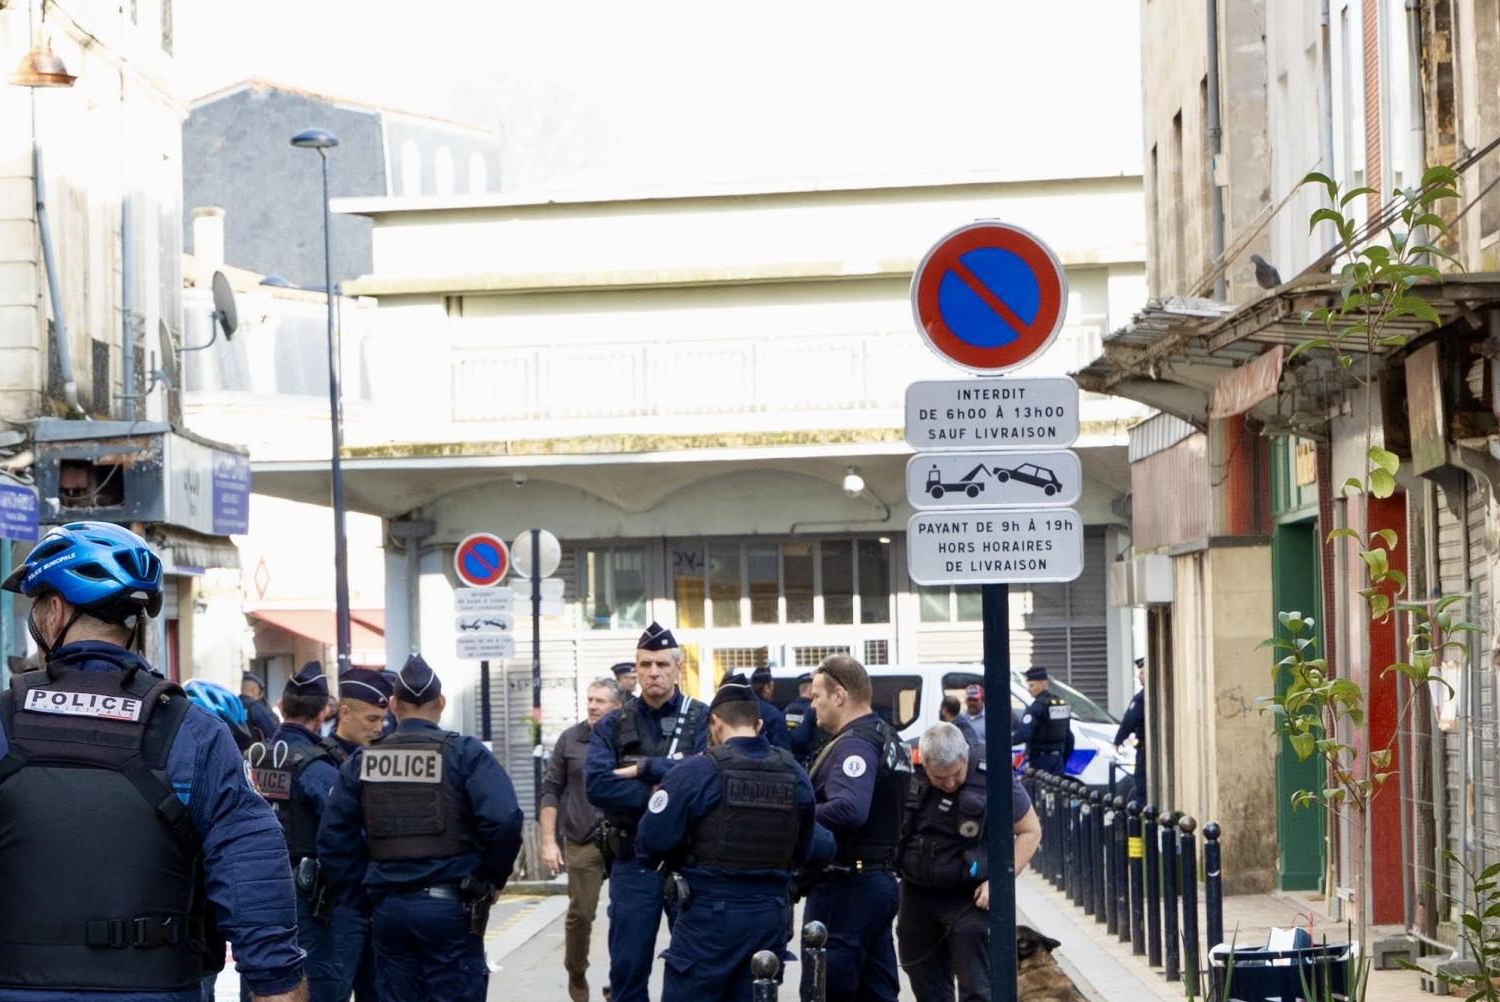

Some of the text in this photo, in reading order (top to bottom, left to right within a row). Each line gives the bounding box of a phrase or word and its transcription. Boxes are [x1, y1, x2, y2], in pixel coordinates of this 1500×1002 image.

[957, 388, 1026, 400] INTERDIT
[919, 405, 1064, 420] DE 6h00 À 13h00
[928, 427, 1056, 440] SAUF LIVRAISON
[918, 518, 1073, 534] PAYANT DE 9h À 19h
[938, 540, 1053, 553] HORS HORAIRES
[946, 559, 1047, 572] DE LIVRAISON
[31, 690, 137, 712] POLICE
[30, 702, 134, 717] MUNICIPALE
[366, 755, 437, 778] POLICE
